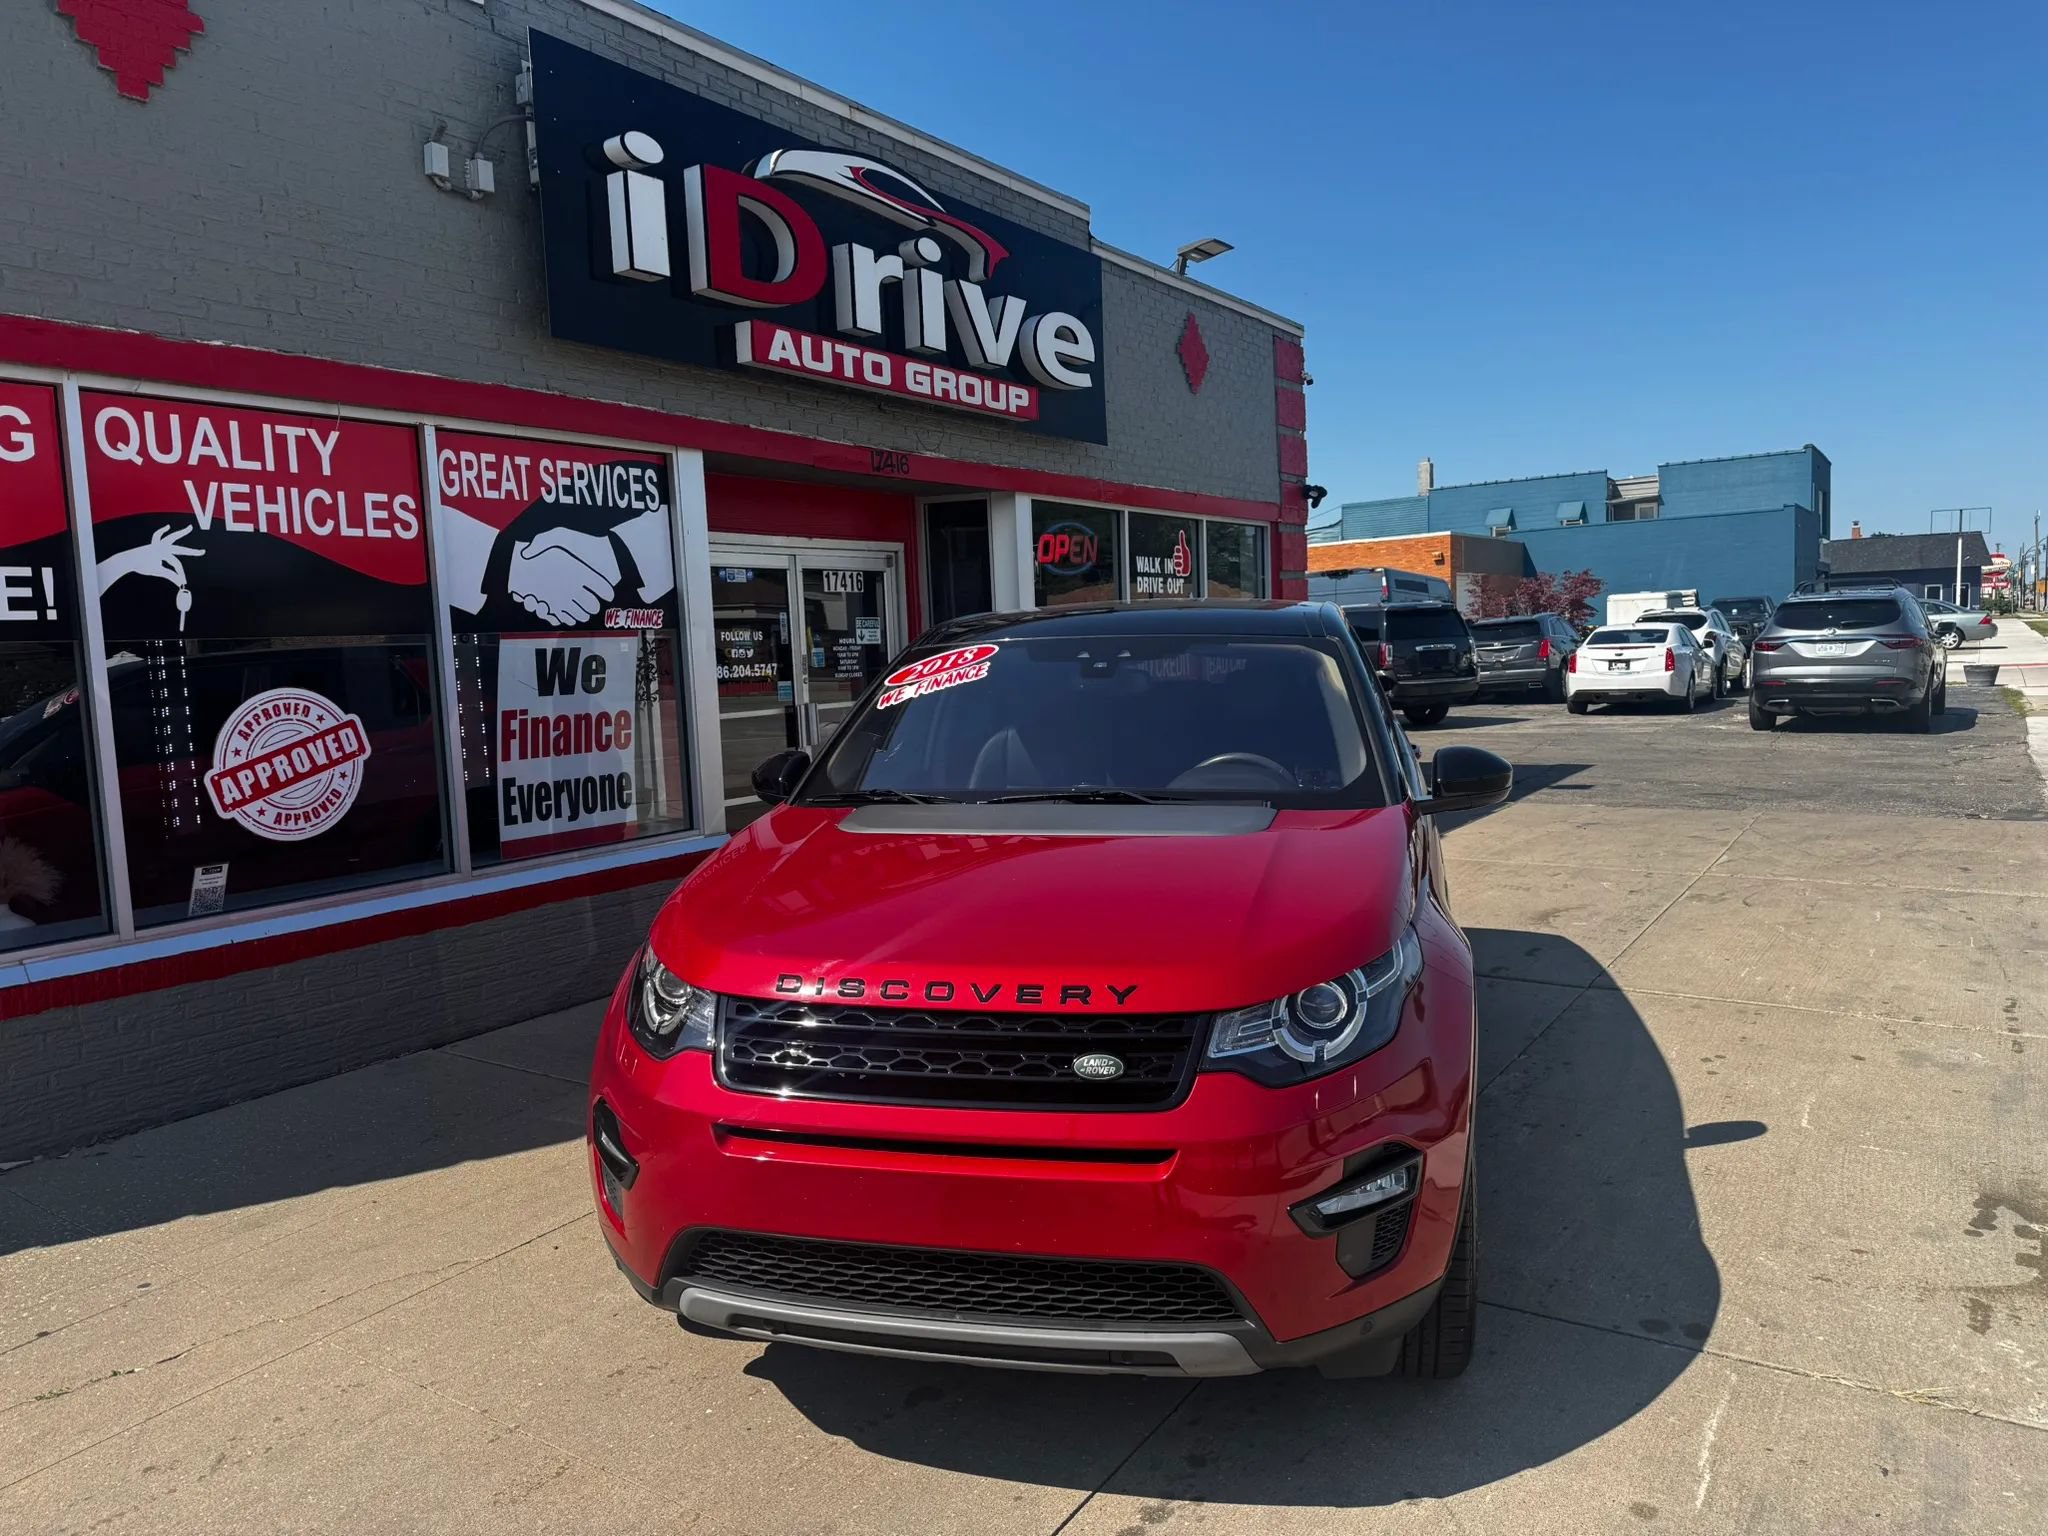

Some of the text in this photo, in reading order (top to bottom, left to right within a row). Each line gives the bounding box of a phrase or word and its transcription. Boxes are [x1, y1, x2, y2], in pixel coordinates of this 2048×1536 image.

[603, 131, 1096, 390] iDrive
[768, 329, 1030, 414] AUTO GROUP
[0, 405, 36, 462] G
[94, 406, 341, 476] QUALITY
[438, 449, 660, 511] GREAT SERVICES
[870, 449, 910, 475] 17416
[183, 479, 420, 540] VEHICLES
[1037, 533, 1098, 565] OPEN
[1136, 556, 1174, 574] WALK IN
[824, 572, 863, 591] 17416
[1137, 577, 1184, 594] DRIVE OUT
[606, 608, 664, 628] WE FINANCE
[720, 631, 763, 641] FOLLOW US
[534, 646, 607, 697] We
[906, 647, 980, 681] 2018
[878, 661, 990, 708] WE FINANCE
[237, 702, 312, 741] APPROVED
[501, 708, 633, 762] Finance
[220, 727, 360, 806] APPROVED
[273, 786, 344, 827] APPROVED
[503, 771, 633, 827] Everyone
[775, 973, 1139, 1005] DISCOVERY
[1083, 1058, 1110, 1068] LAND
[1084, 1065, 1117, 1076] ROVER
